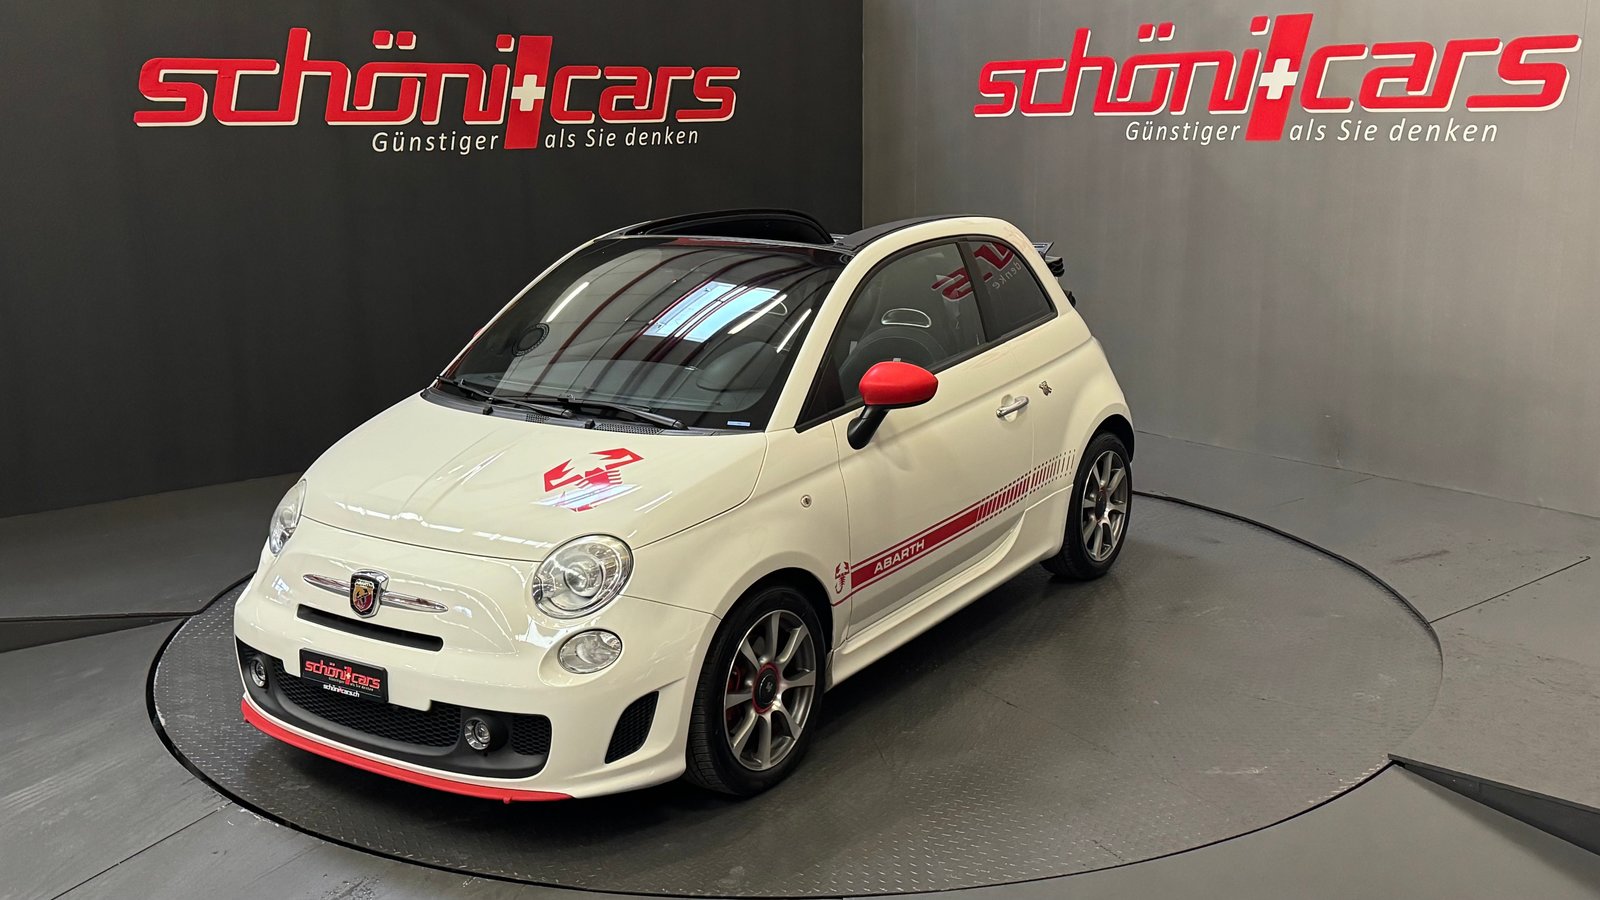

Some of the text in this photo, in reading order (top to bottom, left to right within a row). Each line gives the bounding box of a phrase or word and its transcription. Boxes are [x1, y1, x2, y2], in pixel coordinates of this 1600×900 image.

[372, 126, 698, 155] Günstiger als Sie denken
[1125, 118, 1498, 145] Günstiger als Sie denken
[874, 539, 925, 575] ABARTH
